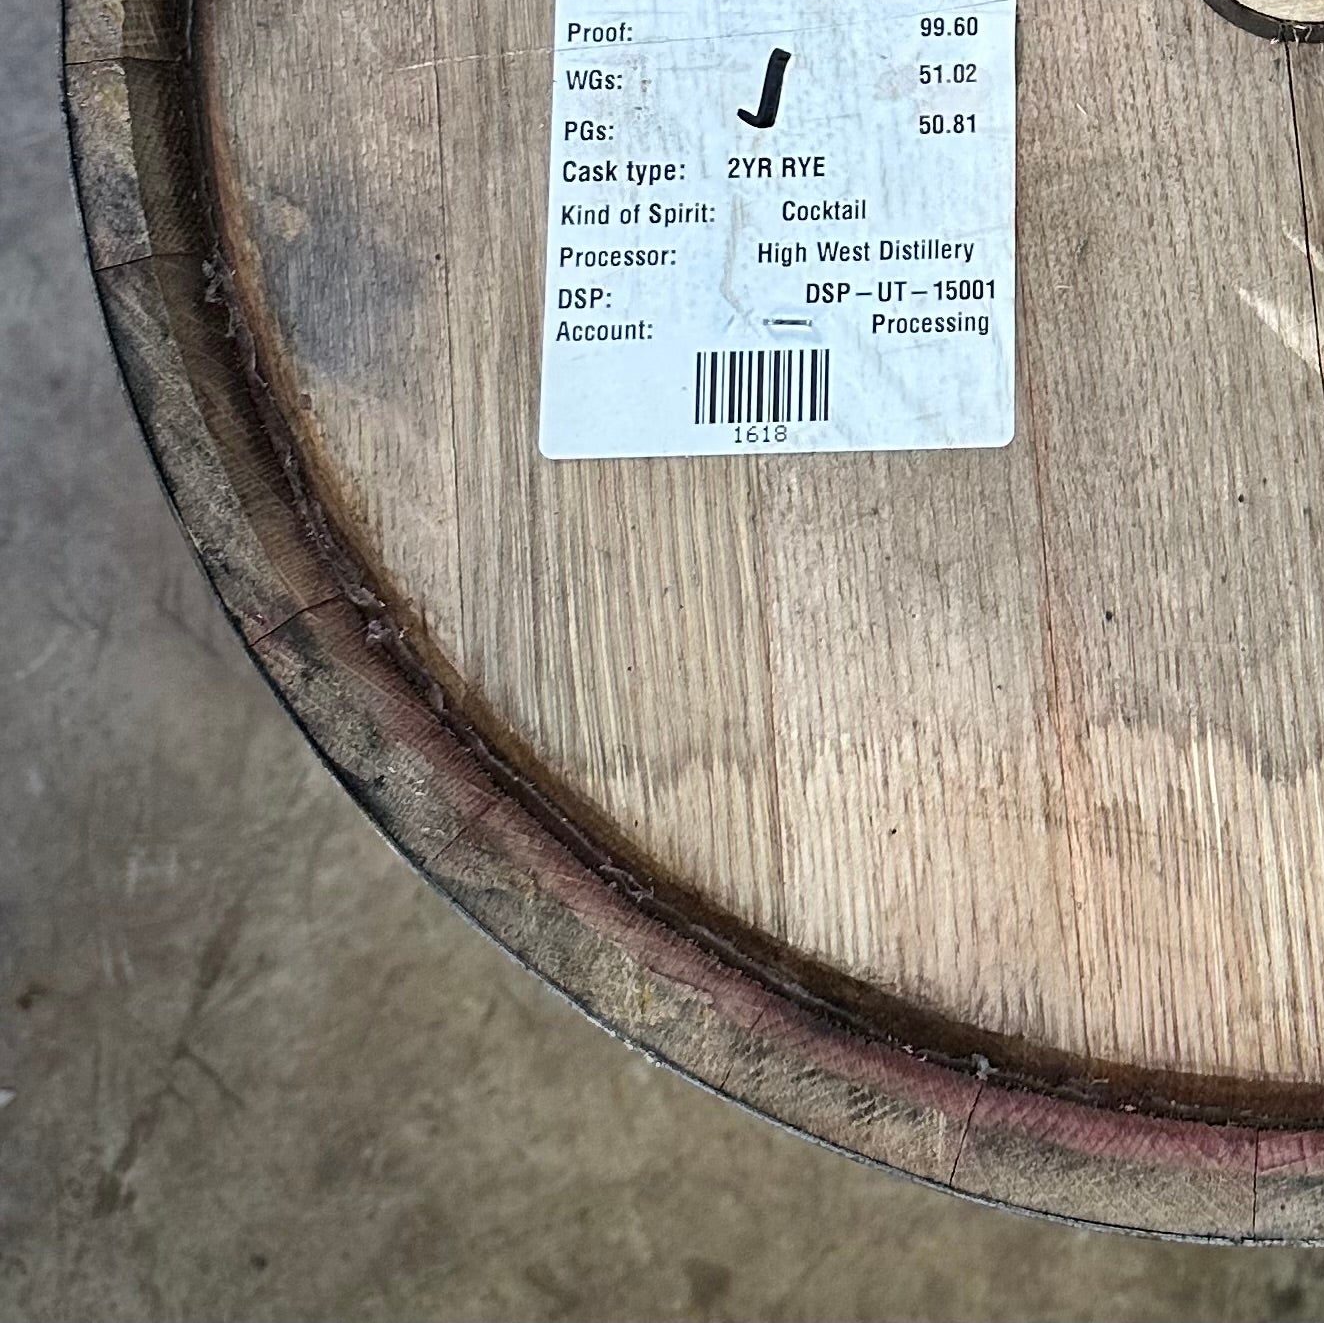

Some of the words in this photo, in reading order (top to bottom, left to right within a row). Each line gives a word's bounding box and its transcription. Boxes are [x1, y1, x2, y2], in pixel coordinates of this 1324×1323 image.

[567, 22, 632, 43] Proof:
[920, 16, 978, 37] 99.60
[566, 70, 623, 91] WGs:
[919, 63, 977, 85] 51.02
[564, 121, 614, 141] PGs:
[919, 114, 975, 135] 50.81
[562, 160, 618, 183] Cask
[626, 160, 685, 186] type:
[727, 157, 772, 179] 2YR
[782, 156, 825, 178] RYE
[561, 204, 610, 226] Kind
[620, 203, 641, 225] of
[649, 202, 715, 227] Spirit:
[782, 199, 866, 222] Cocktail
[560, 246, 676, 268] Processor:
[758, 242, 807, 268] High
[817, 241, 870, 262] West
[879, 239, 974, 263] Distillery
[558, 288, 611, 309] DSP:
[555, 320, 652, 342] Account:
[872, 313, 989, 336] Processing
[734, 425, 787, 444] 1618
